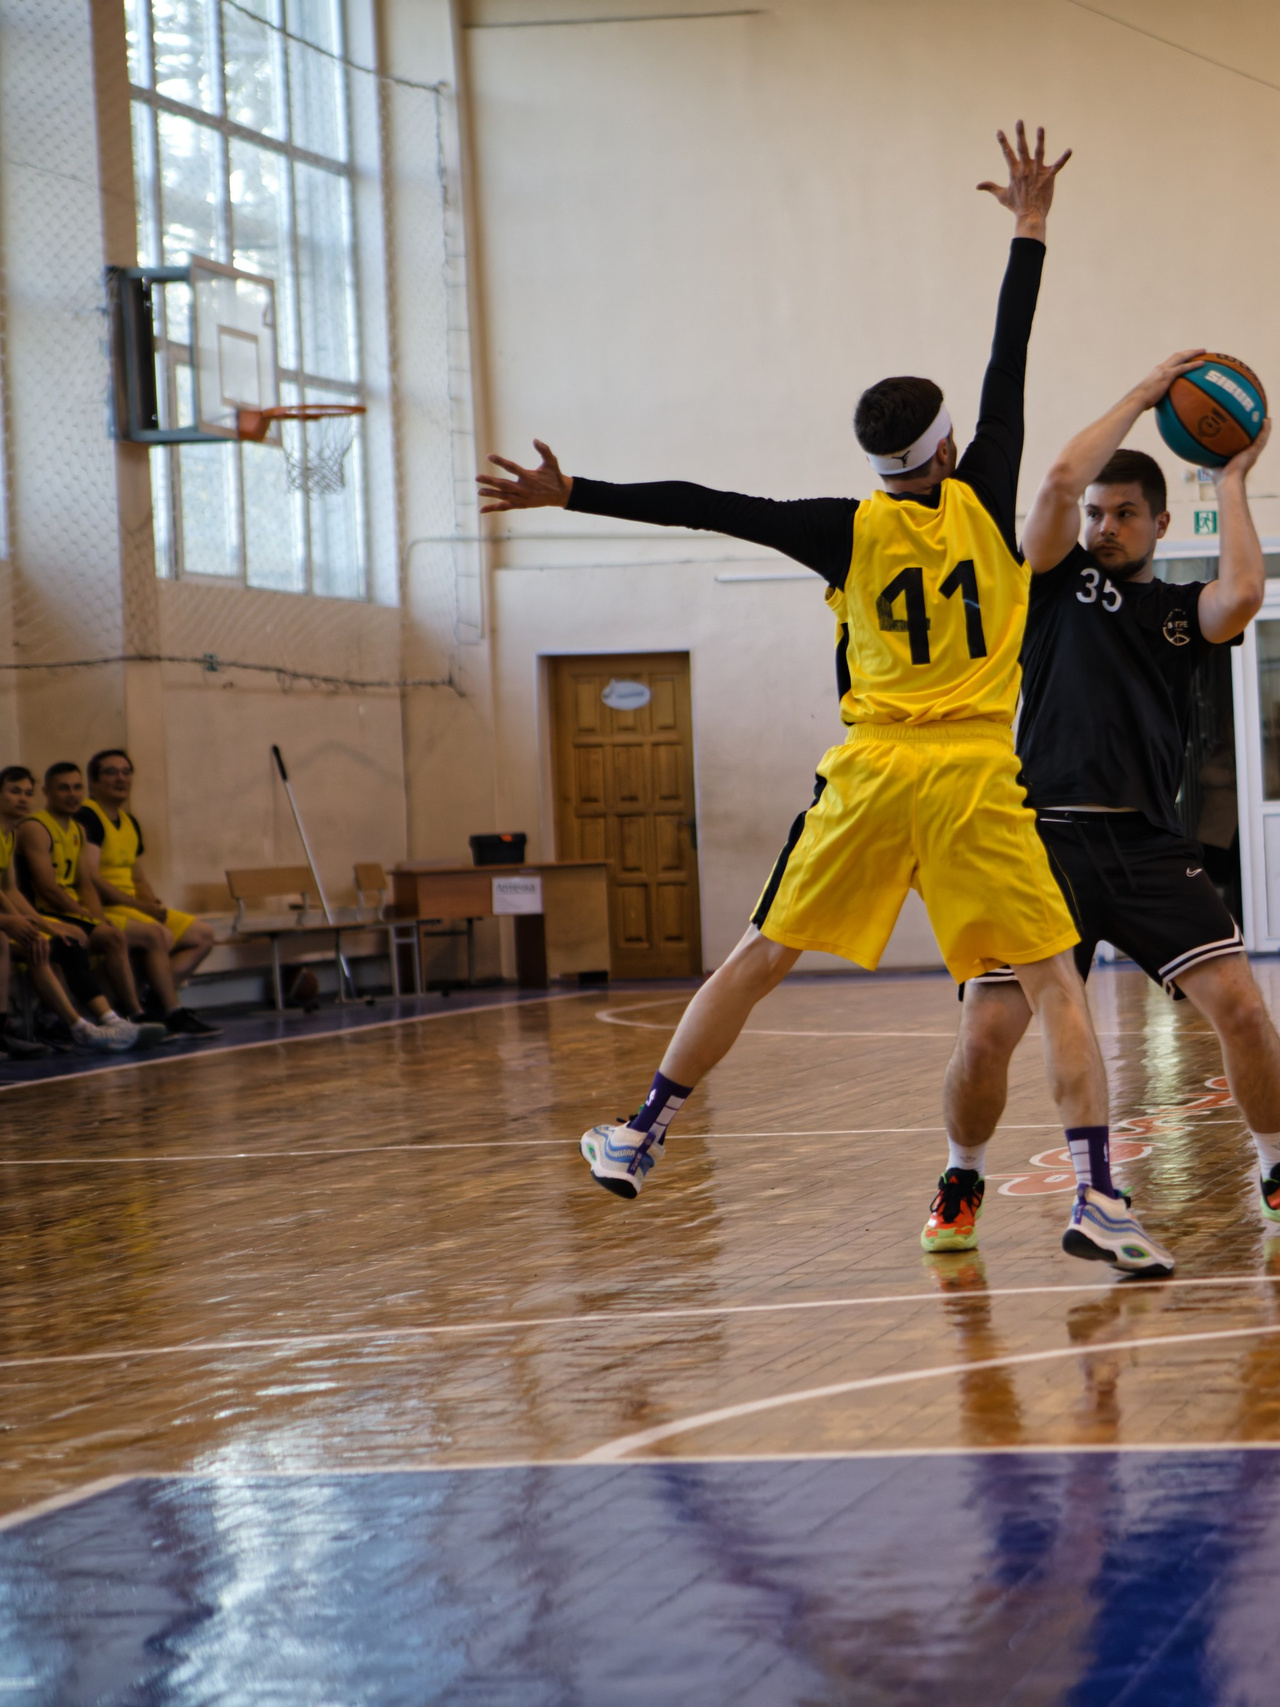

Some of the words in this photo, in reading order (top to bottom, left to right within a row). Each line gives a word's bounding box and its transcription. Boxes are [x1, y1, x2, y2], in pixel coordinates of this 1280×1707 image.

[1204, 369, 1255, 413] SIBUR
[1076, 568, 1122, 612] 35
[876, 559, 988, 666] 41
